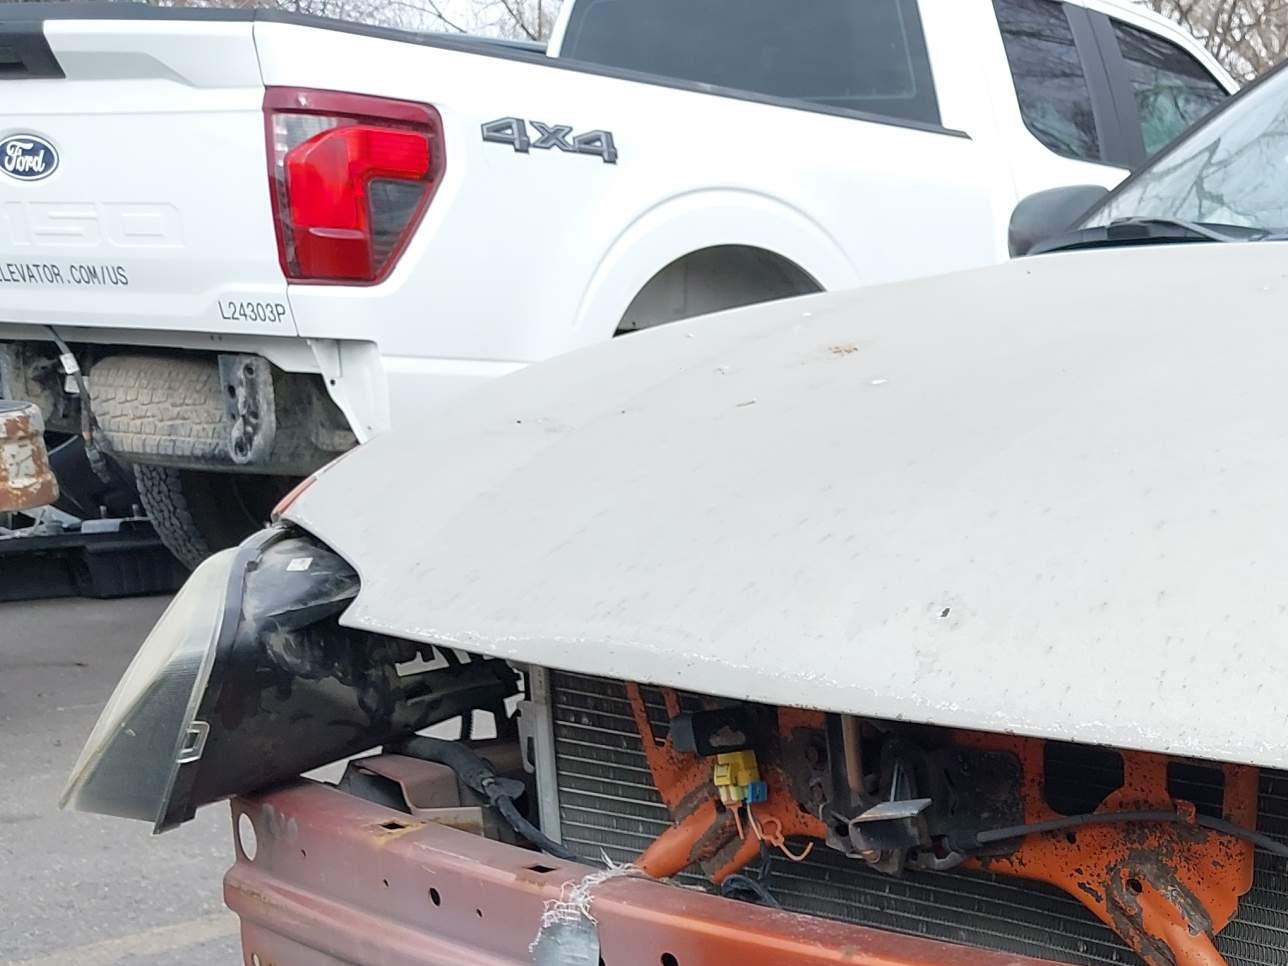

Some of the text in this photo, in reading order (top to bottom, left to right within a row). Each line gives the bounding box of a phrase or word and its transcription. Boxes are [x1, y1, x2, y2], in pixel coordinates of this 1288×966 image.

[4, 141, 46, 172] Ford
[0, 263, 128, 285] LEVATOR.COM/US
[218, 300, 286, 322] L24303P
